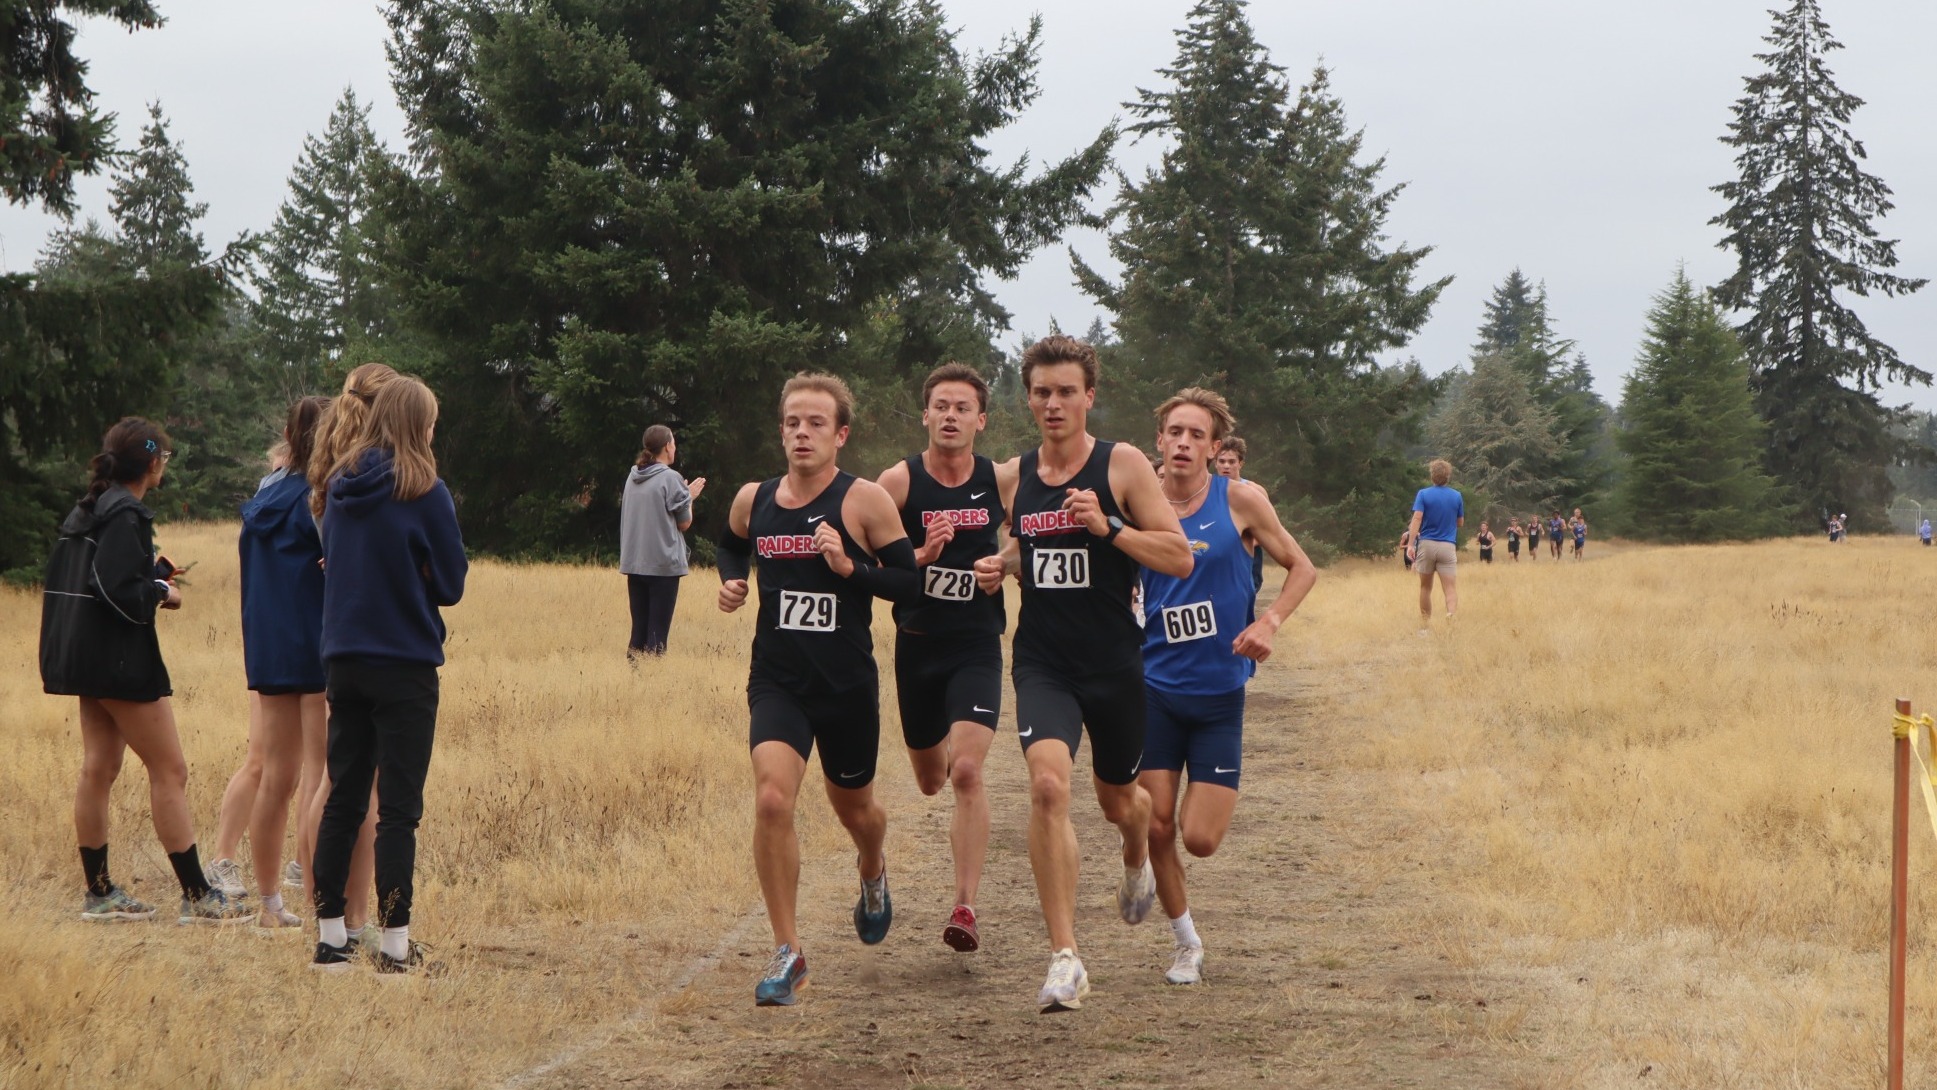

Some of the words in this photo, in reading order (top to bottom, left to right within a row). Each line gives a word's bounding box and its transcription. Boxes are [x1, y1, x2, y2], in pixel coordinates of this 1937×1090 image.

[922, 508, 989, 527] RDERS
[928, 569, 973, 598] 728
[1037, 552, 1085, 584] 730
[783, 594, 833, 628] 729
[1166, 605, 1213, 639] 609
